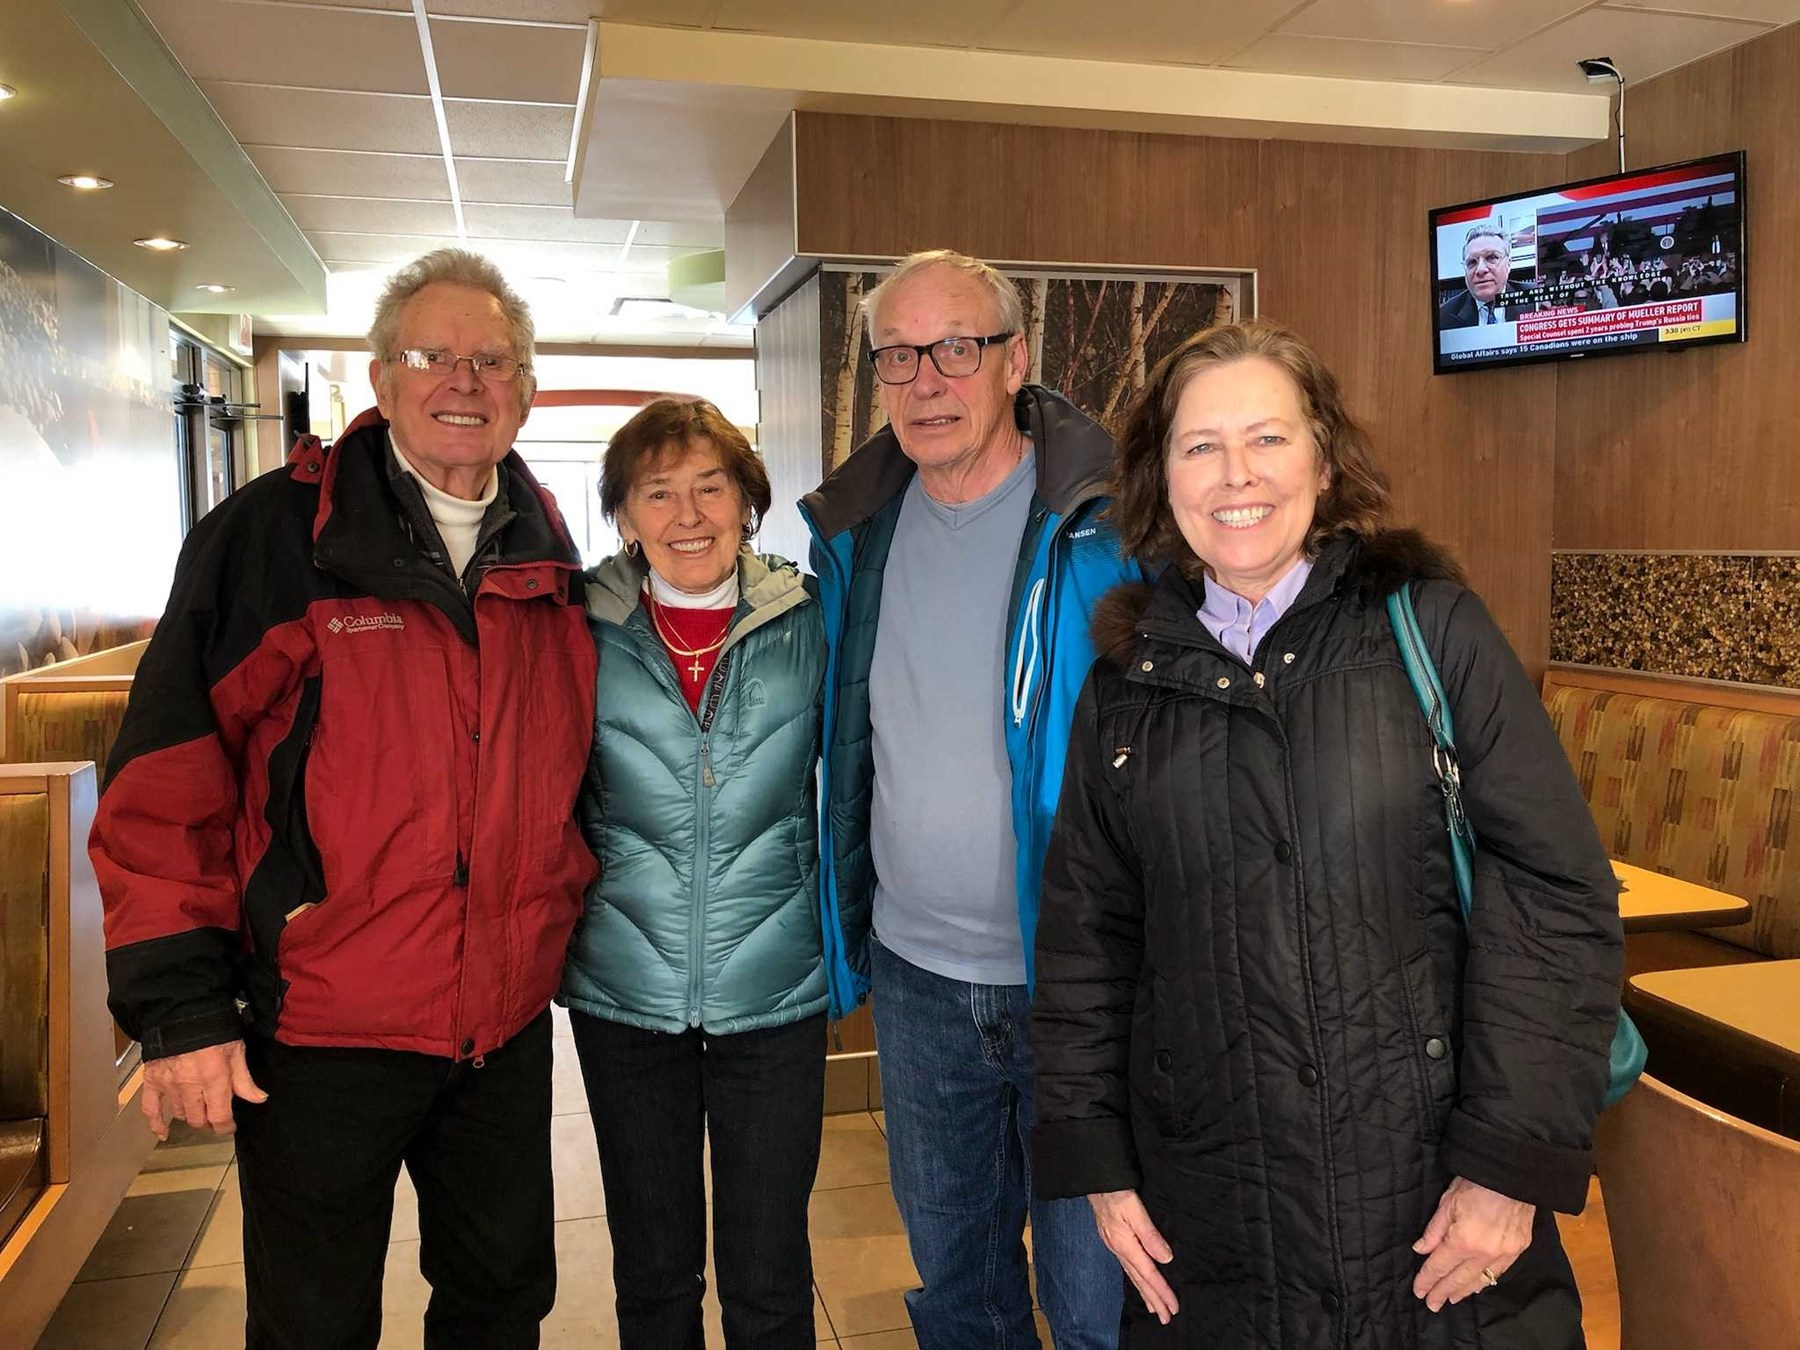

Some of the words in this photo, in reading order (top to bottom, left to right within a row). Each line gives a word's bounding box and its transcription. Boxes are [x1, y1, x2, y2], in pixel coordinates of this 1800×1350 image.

[1500, 291, 1523, 299] TRUMP
[1549, 282, 1585, 292] WITHOUT
[1612, 271, 1661, 283] KNOWLEDGE
[1519, 309, 1555, 320] BREAKING
[1557, 307, 1579, 316] NEWS
[1519, 321, 1557, 333] CONGRESS
[1558, 318, 1577, 328] GETS
[1578, 313, 1615, 326] SUMMARY
[1617, 312, 1627, 320] OF
[1628, 307, 1666, 319] MUELLER
[1666, 302, 1698, 314] REPORT
[1519, 333, 1541, 342] Special
[1542, 330, 1567, 339] Counsel
[1567, 328, 1584, 337] spent
[1590, 325, 1608, 334] years
[1609, 321, 1634, 331] probing
[1635, 318, 1662, 327] Trump's
[1663, 315, 1686, 323] Russia
[1450, 352, 1474, 360] Global
[1475, 349, 1500, 358] Affairs
[1501, 347, 1517, 356] says
[1529, 341, 1569, 351] Canadians
[1620, 333, 1638, 341] ship
[1066, 527, 1097, 539] ANSEN
[343, 612, 403, 628] Columbia
